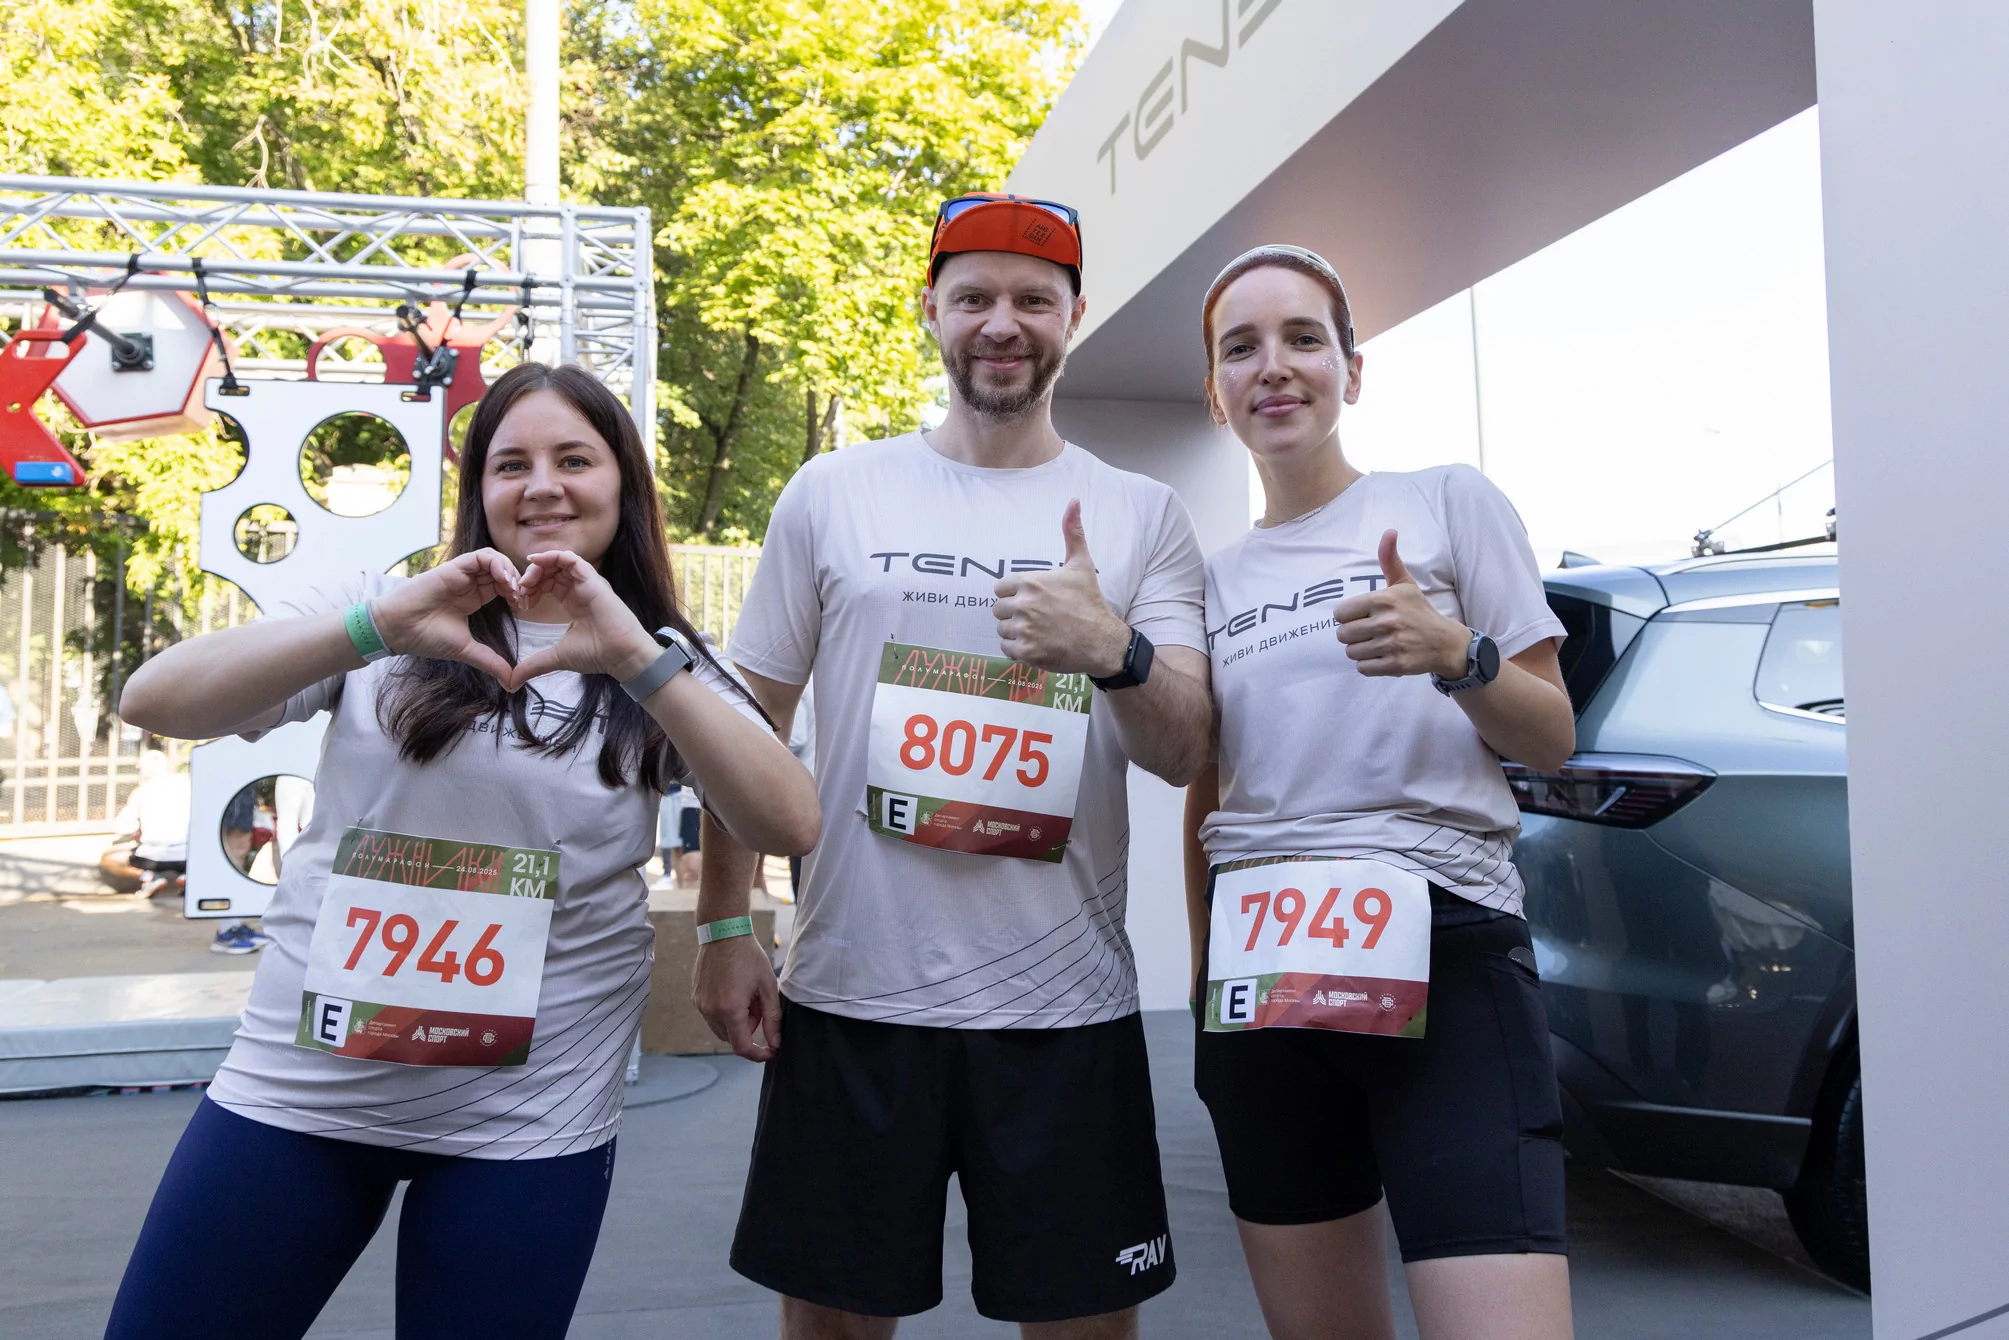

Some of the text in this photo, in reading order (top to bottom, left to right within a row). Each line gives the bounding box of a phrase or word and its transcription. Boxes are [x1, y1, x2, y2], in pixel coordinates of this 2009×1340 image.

[869, 552, 1099, 579] TENE
[902, 590, 948, 604] ЖИВИ
[1222, 644, 1253, 668] ЖИВИ
[901, 664, 1043, 690] ПОЛУМАРАФОН 24.08.2025
[1055, 672, 1087, 693] 21,1
[900, 713, 1053, 788] 8075
[888, 797, 909, 831] E
[352, 851, 498, 876] ПОЛУМАРАФОН 24.08.2025
[512, 852, 550, 877] 21,1
[1240, 887, 1393, 952] 7949
[342, 906, 505, 987] 7946
[1229, 984, 1249, 1020] E
[1328, 991, 1368, 1001] МОСКОВСКИЙ
[1328, 998, 1347, 1007] СПОРТ
[320, 1003, 343, 1042] E
[428, 1026, 470, 1037] МОСКОВСКИЙ
[427, 1034, 448, 1043] СПОРТ
[1115, 1233, 1167, 1276] RAY
